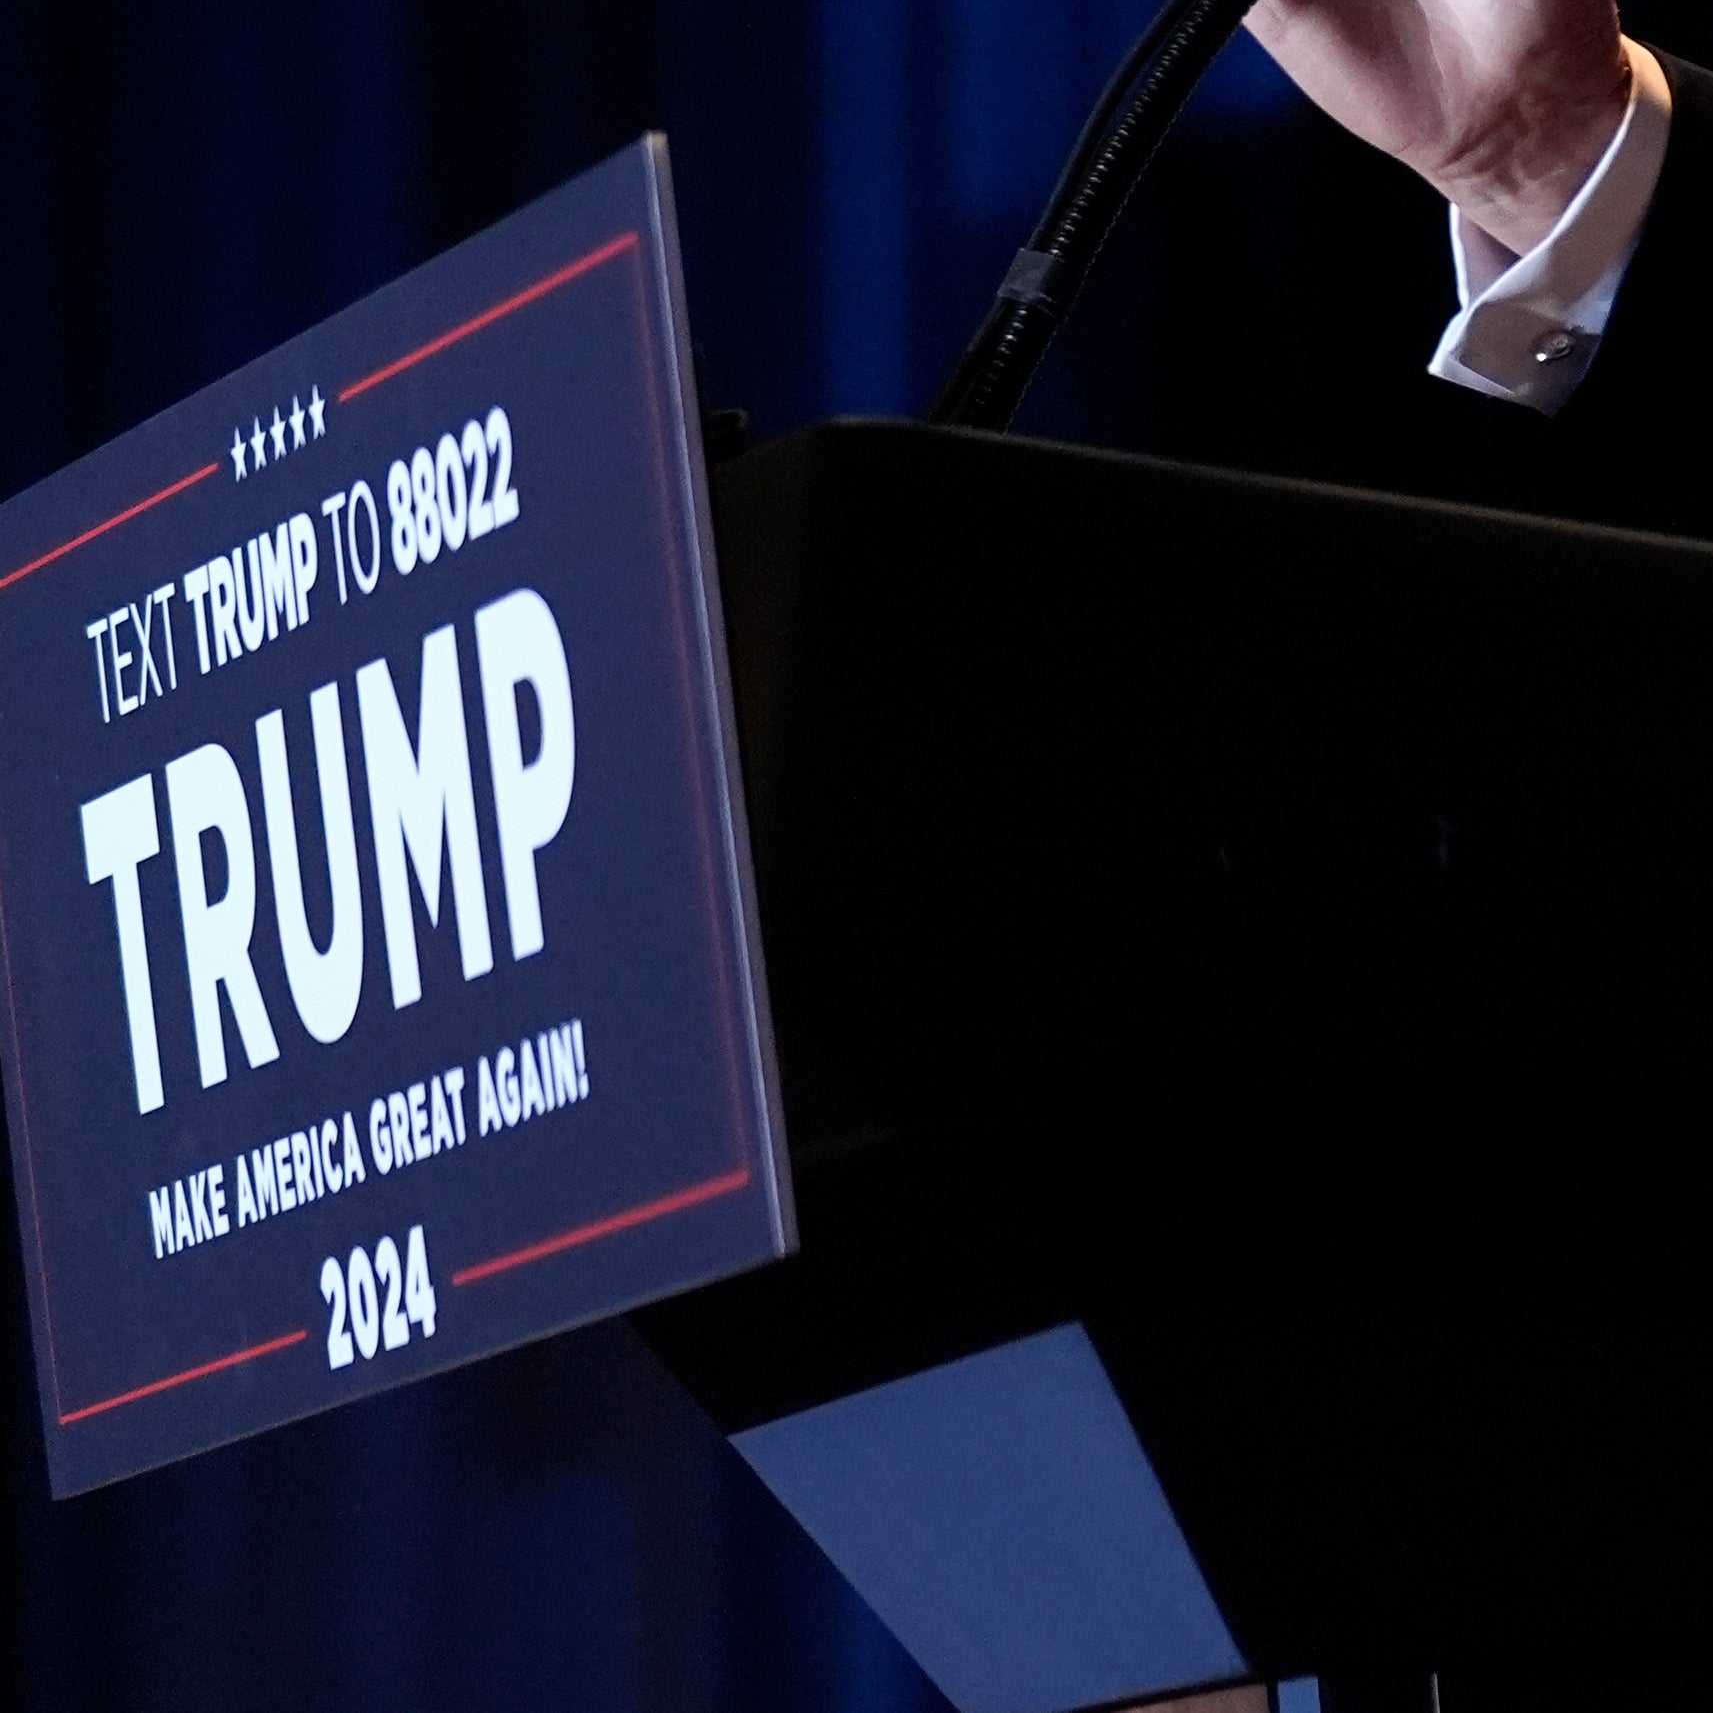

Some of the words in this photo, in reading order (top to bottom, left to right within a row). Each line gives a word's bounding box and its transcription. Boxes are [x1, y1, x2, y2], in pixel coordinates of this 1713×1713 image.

[85, 581, 177, 725] TEXT
[183, 522, 318, 675] TRUMP
[321, 479, 381, 606] TO
[386, 406, 520, 576] 88022
[80, 588, 576, 1115] TRUMP
[147, 1163, 230, 1260] MAKE
[235, 1111, 366, 1228] AMERICA
[369, 1075, 467, 1175] GREAT
[478, 1019, 590, 1137] AGAIN!
[319, 1224, 437, 1370] 2024
